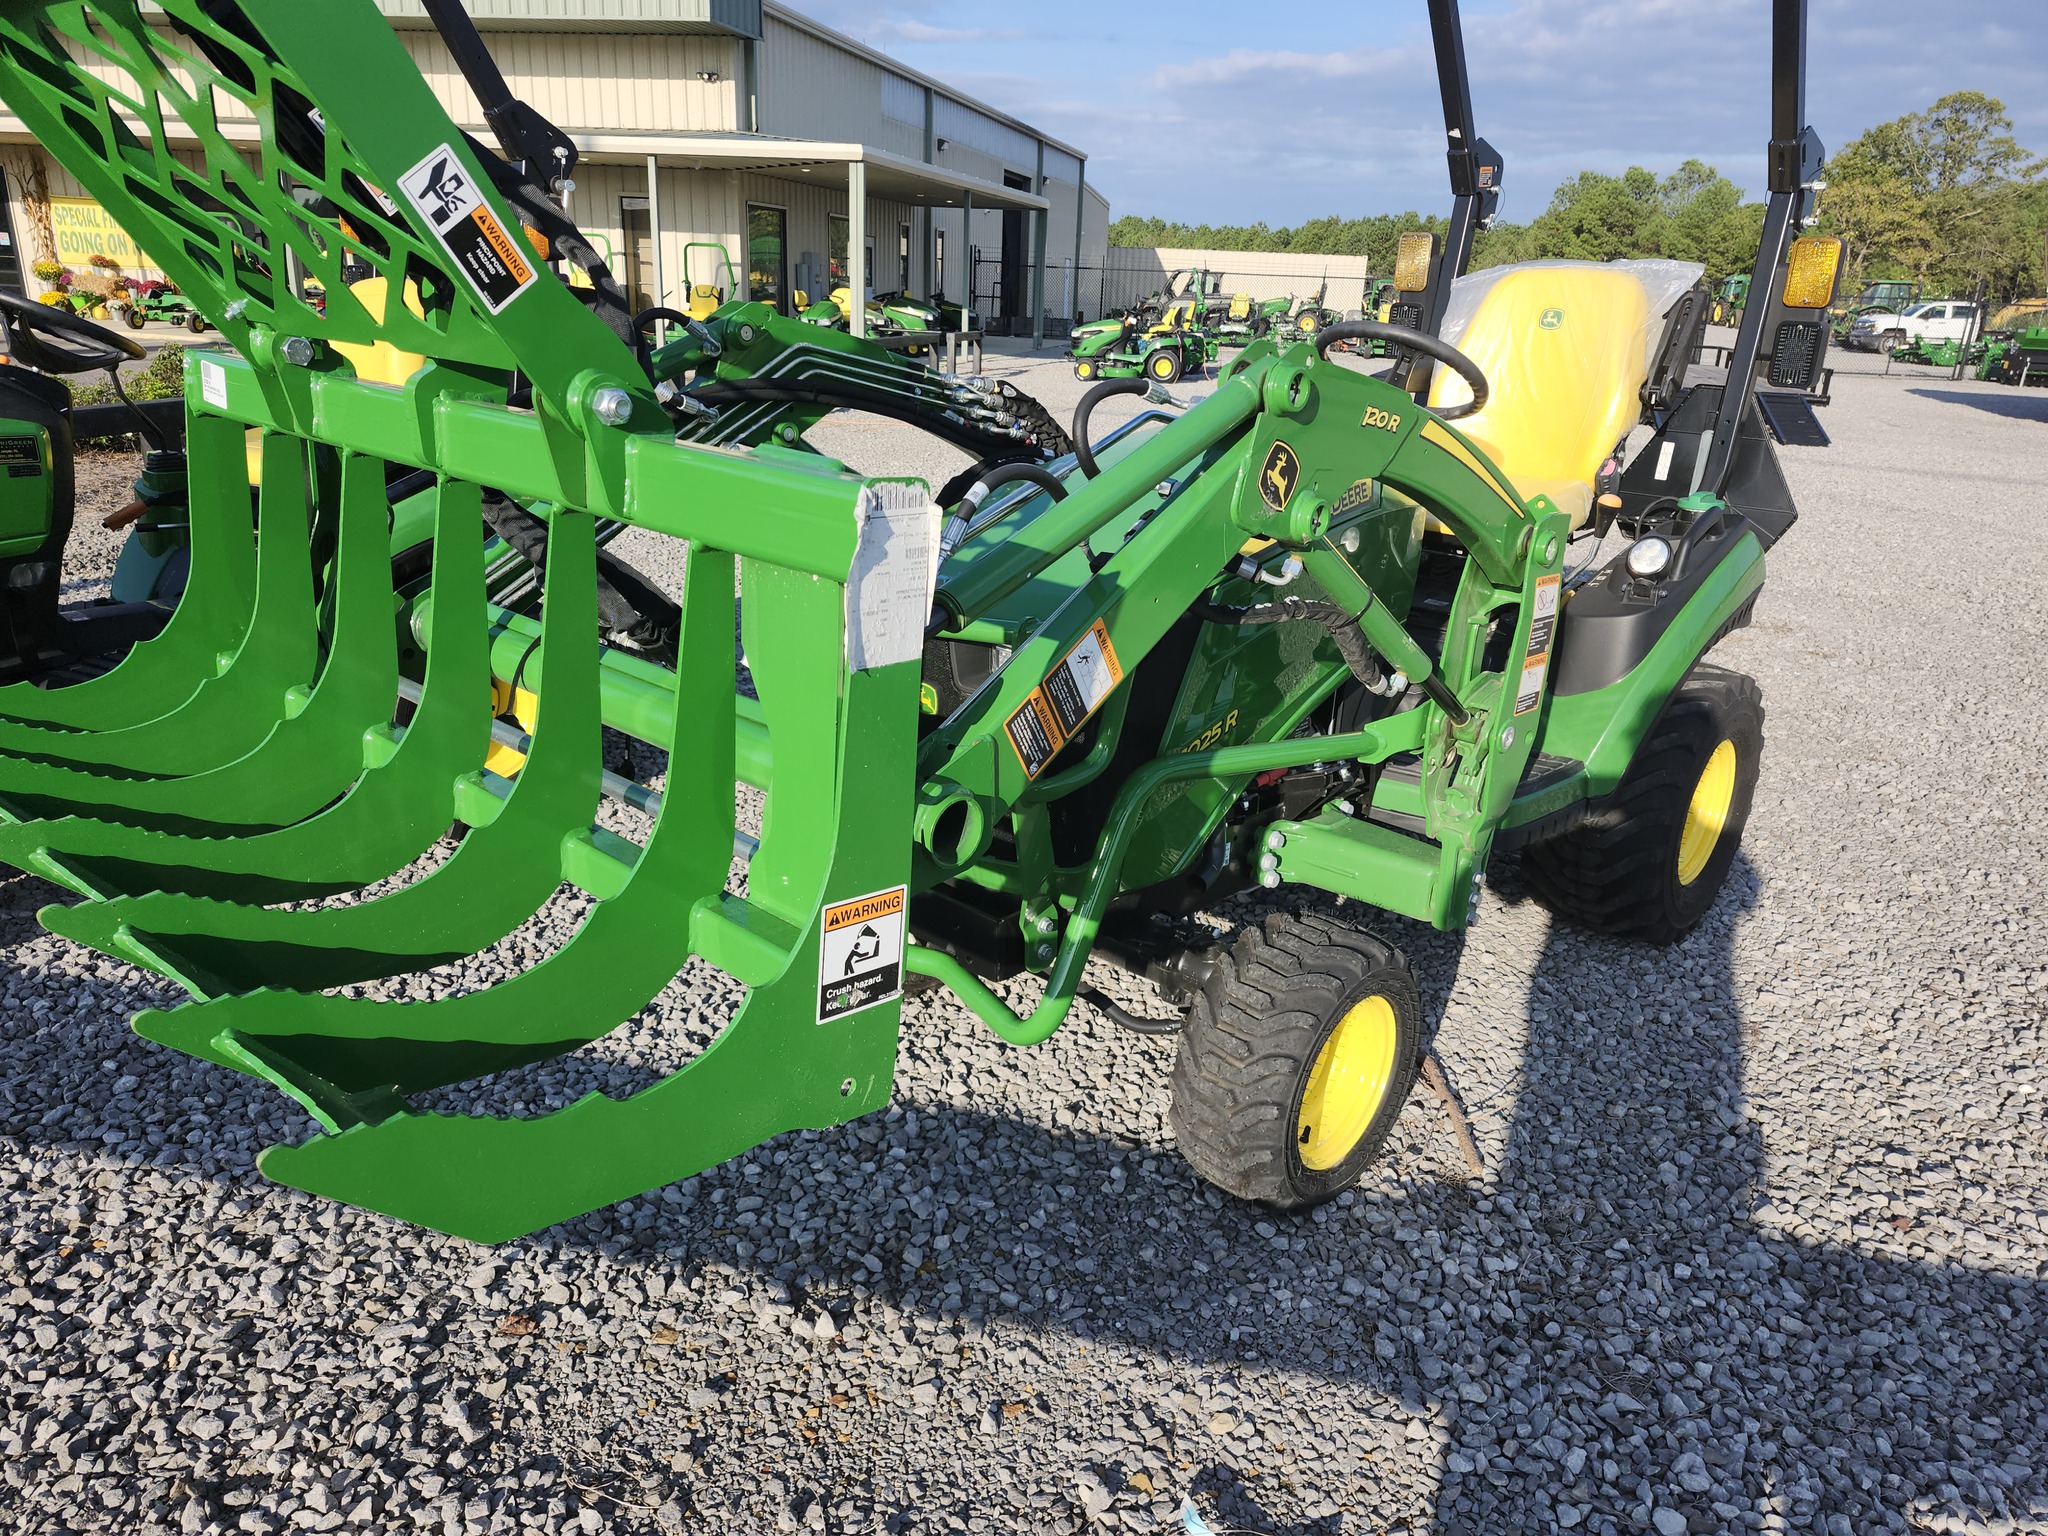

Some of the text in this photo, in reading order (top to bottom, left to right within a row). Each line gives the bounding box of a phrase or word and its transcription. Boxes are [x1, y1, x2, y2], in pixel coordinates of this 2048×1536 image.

[54, 205, 101, 229] SPECIAL
[60, 230, 104, 255] GOING
[107, 233, 129, 256] ON
[476, 237, 492, 258] PINCH
[490, 256, 507, 277] POINT
[486, 222, 526, 278] WARNING
[466, 252, 479, 270] Keep
[477, 268, 490, 284] clear
[475, 248, 496, 275] HAZARD
[1361, 405, 1401, 433] 120R
[1101, 637, 1118, 676] WARNING
[1039, 706, 1058, 745] WARNING
[840, 895, 901, 923] WARNING
[826, 973, 884, 999] Crush hazard.
